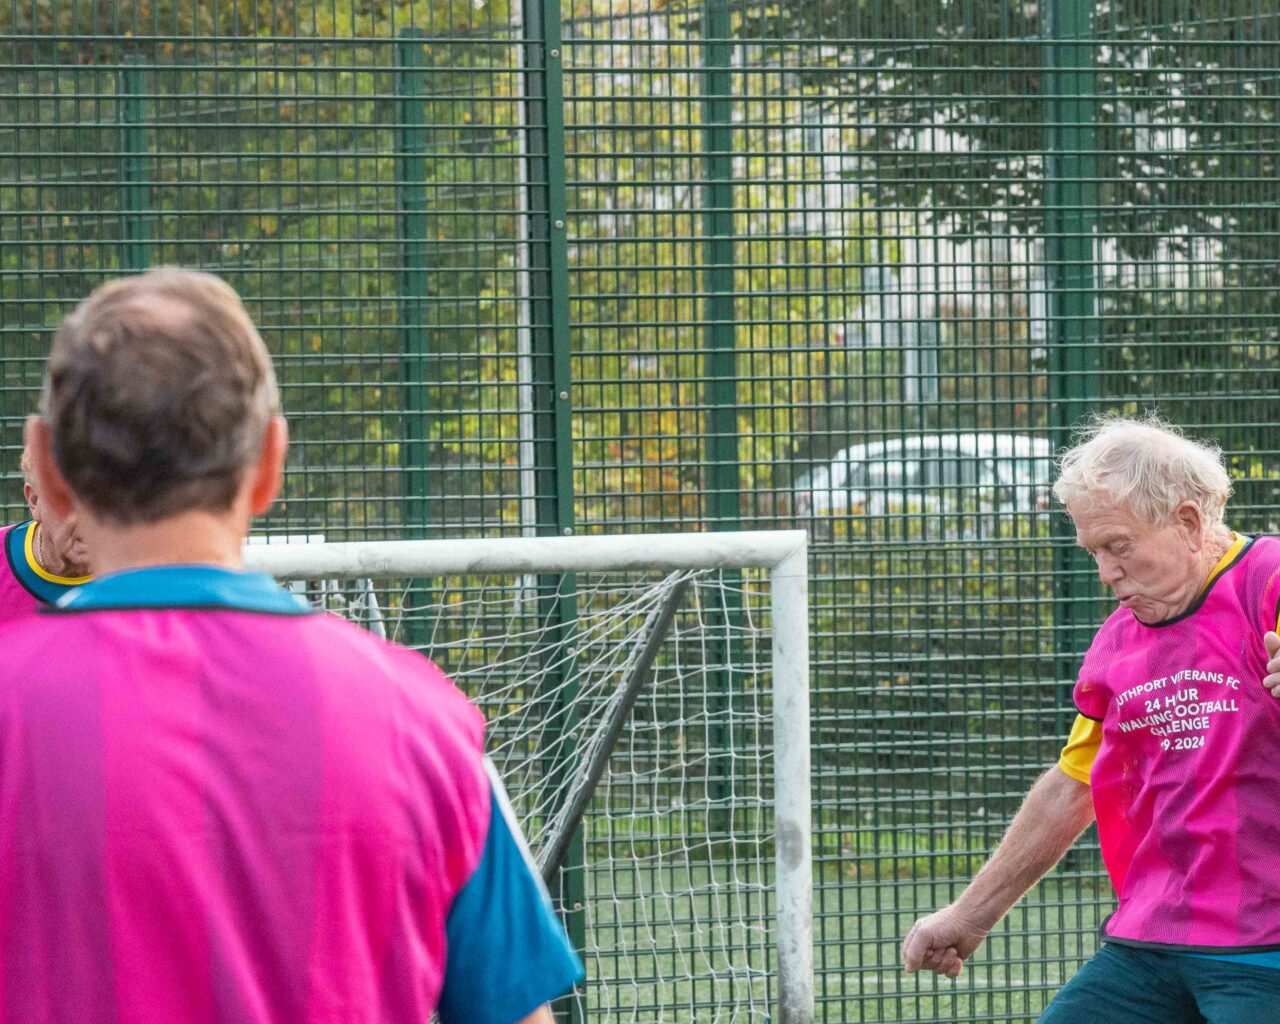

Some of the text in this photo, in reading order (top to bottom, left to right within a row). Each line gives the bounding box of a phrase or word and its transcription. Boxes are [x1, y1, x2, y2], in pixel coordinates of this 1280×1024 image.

[1116, 677, 1168, 706] UTHPORT
[1226, 677, 1240, 689] FC
[1145, 688, 1198, 712] 24 HUR
[1119, 700, 1238, 732] WALKING OOTBALL
[1161, 736, 1204, 750] 9.2024
